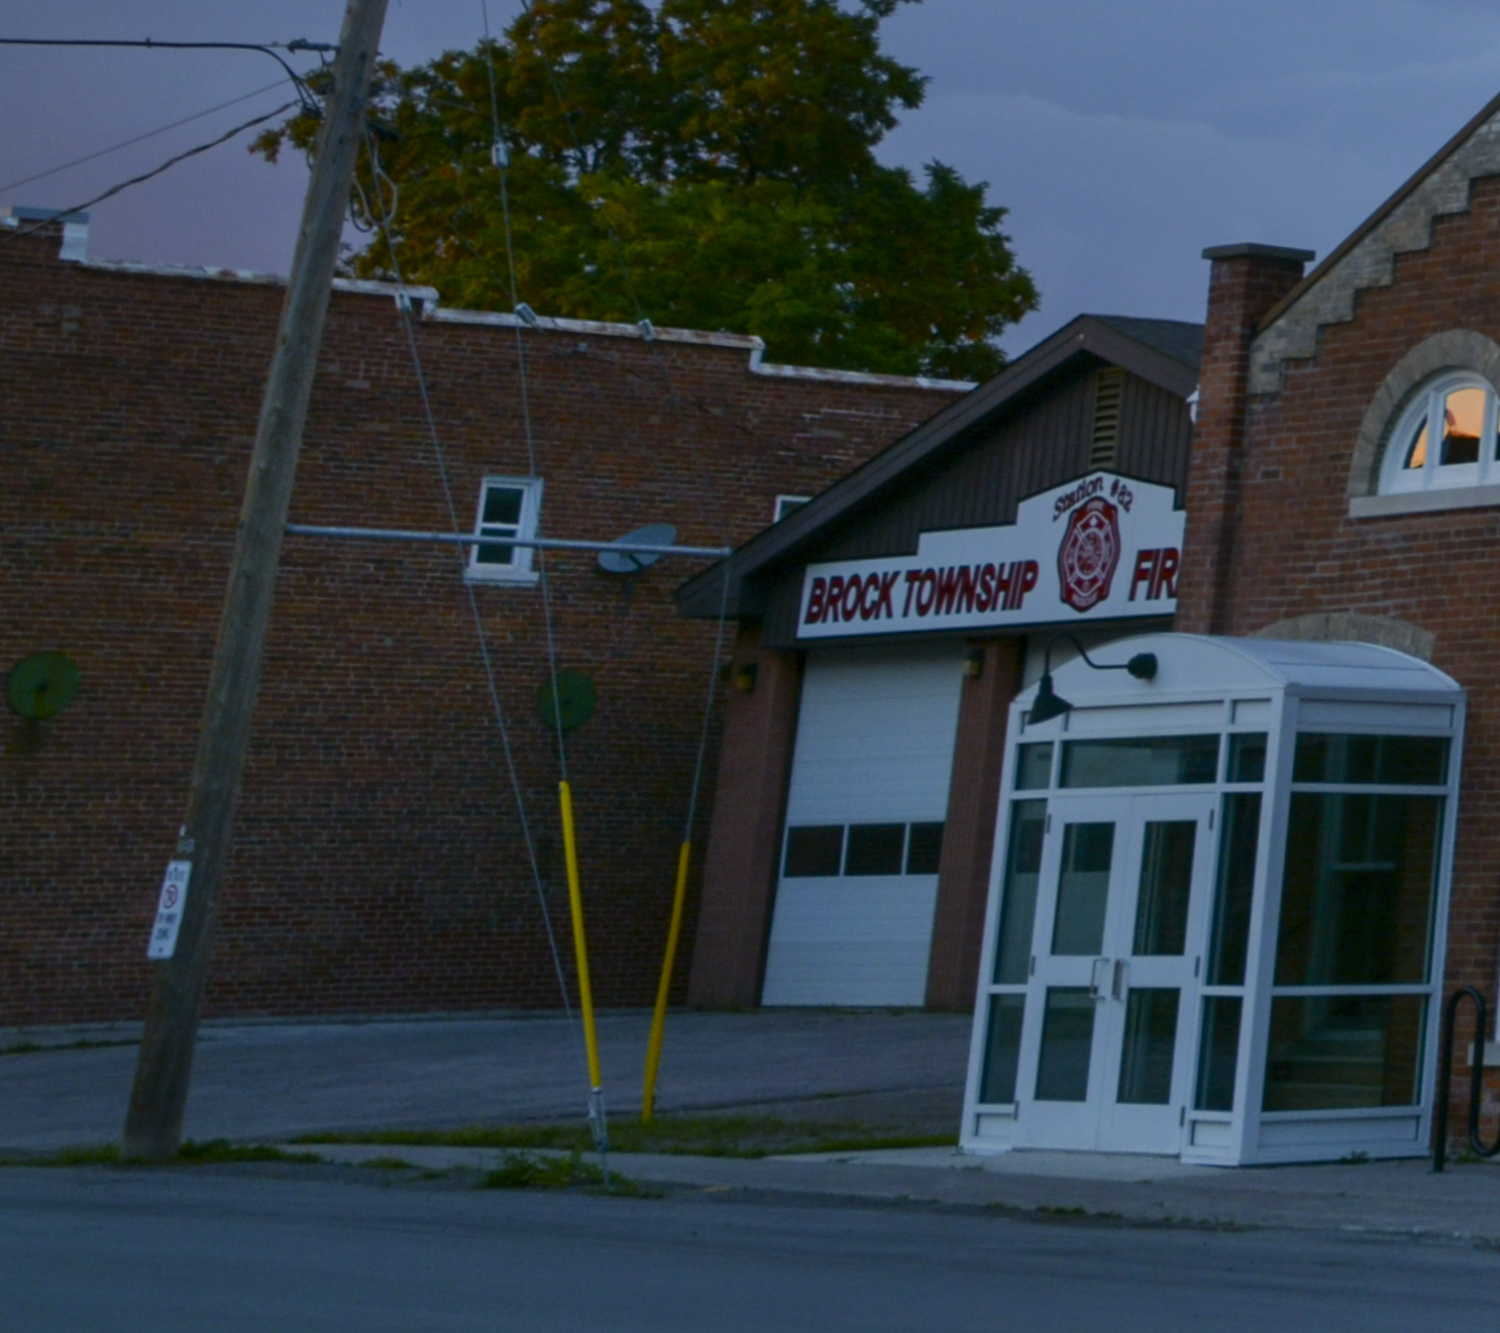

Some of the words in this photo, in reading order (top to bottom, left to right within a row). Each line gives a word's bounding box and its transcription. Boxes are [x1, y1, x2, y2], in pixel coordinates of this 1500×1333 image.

[1052, 476, 1104, 523] Station
[804, 570, 902, 625] BROCK
[902, 559, 1039, 619] TOWNSHIP
